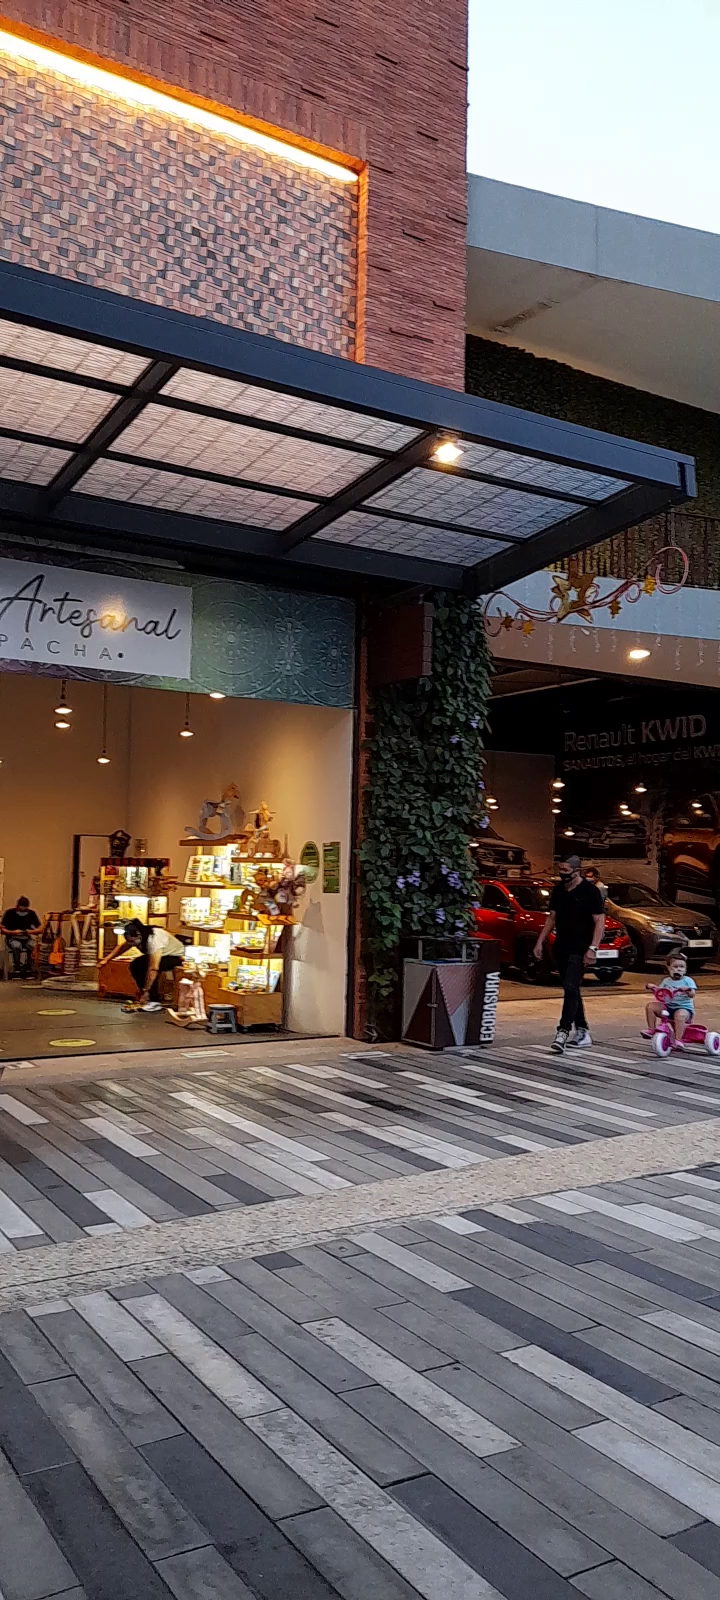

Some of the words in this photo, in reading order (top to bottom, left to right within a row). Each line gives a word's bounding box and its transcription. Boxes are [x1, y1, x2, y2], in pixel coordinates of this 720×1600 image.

[0, 574, 181, 640] Artesanal
[564, 723, 635, 751] Renault
[640, 714, 707, 743] KWID
[638, 751, 672, 767] hogar
[480, 972, 501, 1042] ECOBASURA
